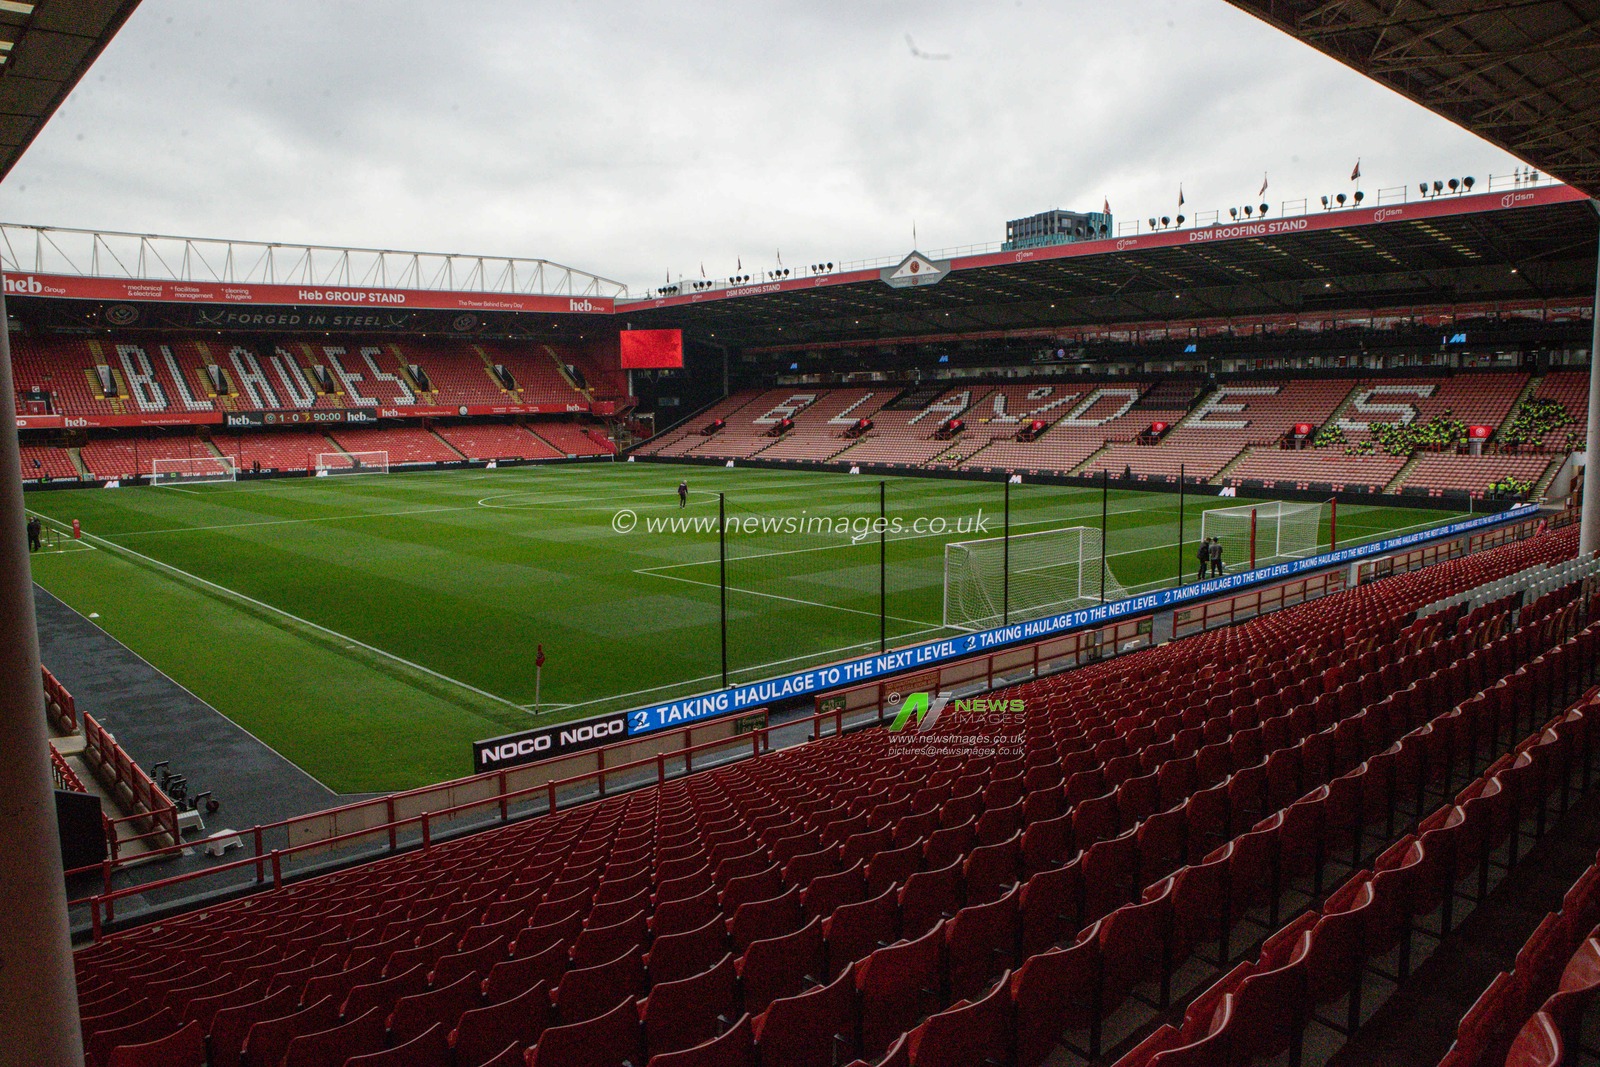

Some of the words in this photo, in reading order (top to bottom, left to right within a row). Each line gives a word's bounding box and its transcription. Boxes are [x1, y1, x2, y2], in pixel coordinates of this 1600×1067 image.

[1515, 192, 1535, 201] dsm
[1385, 208, 1403, 216] dsm
[1189, 230, 1213, 242] DSM
[1215, 223, 1266, 239] ROOFING
[1268, 219, 1307, 234] STAND
[44, 287, 66, 295] Group
[128, 284, 163, 292] mechanical
[738, 287, 762, 296] ROOFING
[762, 284, 781, 293] STAND
[298, 290, 323, 301] Heb
[325, 291, 366, 302] GROUP
[368, 292, 405, 304] STAND
[484, 300, 500, 308] Behind
[570, 299, 592, 312] heb
[227, 313, 300, 325] FORGED
[308, 315, 326, 325] IN
[333, 315, 382, 326] STEEL
[115, 344, 417, 412] BLADES
[382, 408, 398, 417] heb
[566, 404, 580, 412] heb
[64, 418, 87, 427] heb
[228, 415, 250, 426] heb
[280, 414, 284, 422] 1
[292, 414, 299, 422] 0
[314, 413, 340, 421] 90:00
[347, 412, 366, 422] heb
[1299, 558, 1318, 571] TAKING
[1318, 552, 1340, 566] HAULAGE
[1341, 550, 1348, 560] TO
[1348, 548, 1356, 558] THE
[1356, 546, 1368, 557] NEXT
[1368, 542, 1381, 554] LEVEL
[1173, 585, 1200, 600] TAKING
[1200, 576, 1232, 594] HAULAGE
[1233, 575, 1242, 586] TO
[1243, 572, 1254, 582] THE
[1256, 568, 1272, 581] NEXT
[1272, 564, 1290, 578] LEVEL
[980, 626, 1022, 647] TAKING
[1024, 614, 1072, 637] HAULAGE
[1074, 612, 1087, 624] TO
[1090, 606, 1106, 620] THE
[1108, 600, 1131, 616] NEXT
[1133, 595, 1158, 611] LEVEL
[656, 692, 728, 725] TAKING
[734, 674, 814, 707] HAULAGE
[818, 669, 840, 686] TO
[844, 661, 872, 680] THE
[877, 652, 913, 673] NEXT
[916, 641, 956, 663] LEVEL
[482, 735, 551, 764] NOCO
[560, 718, 624, 746] NOCO
